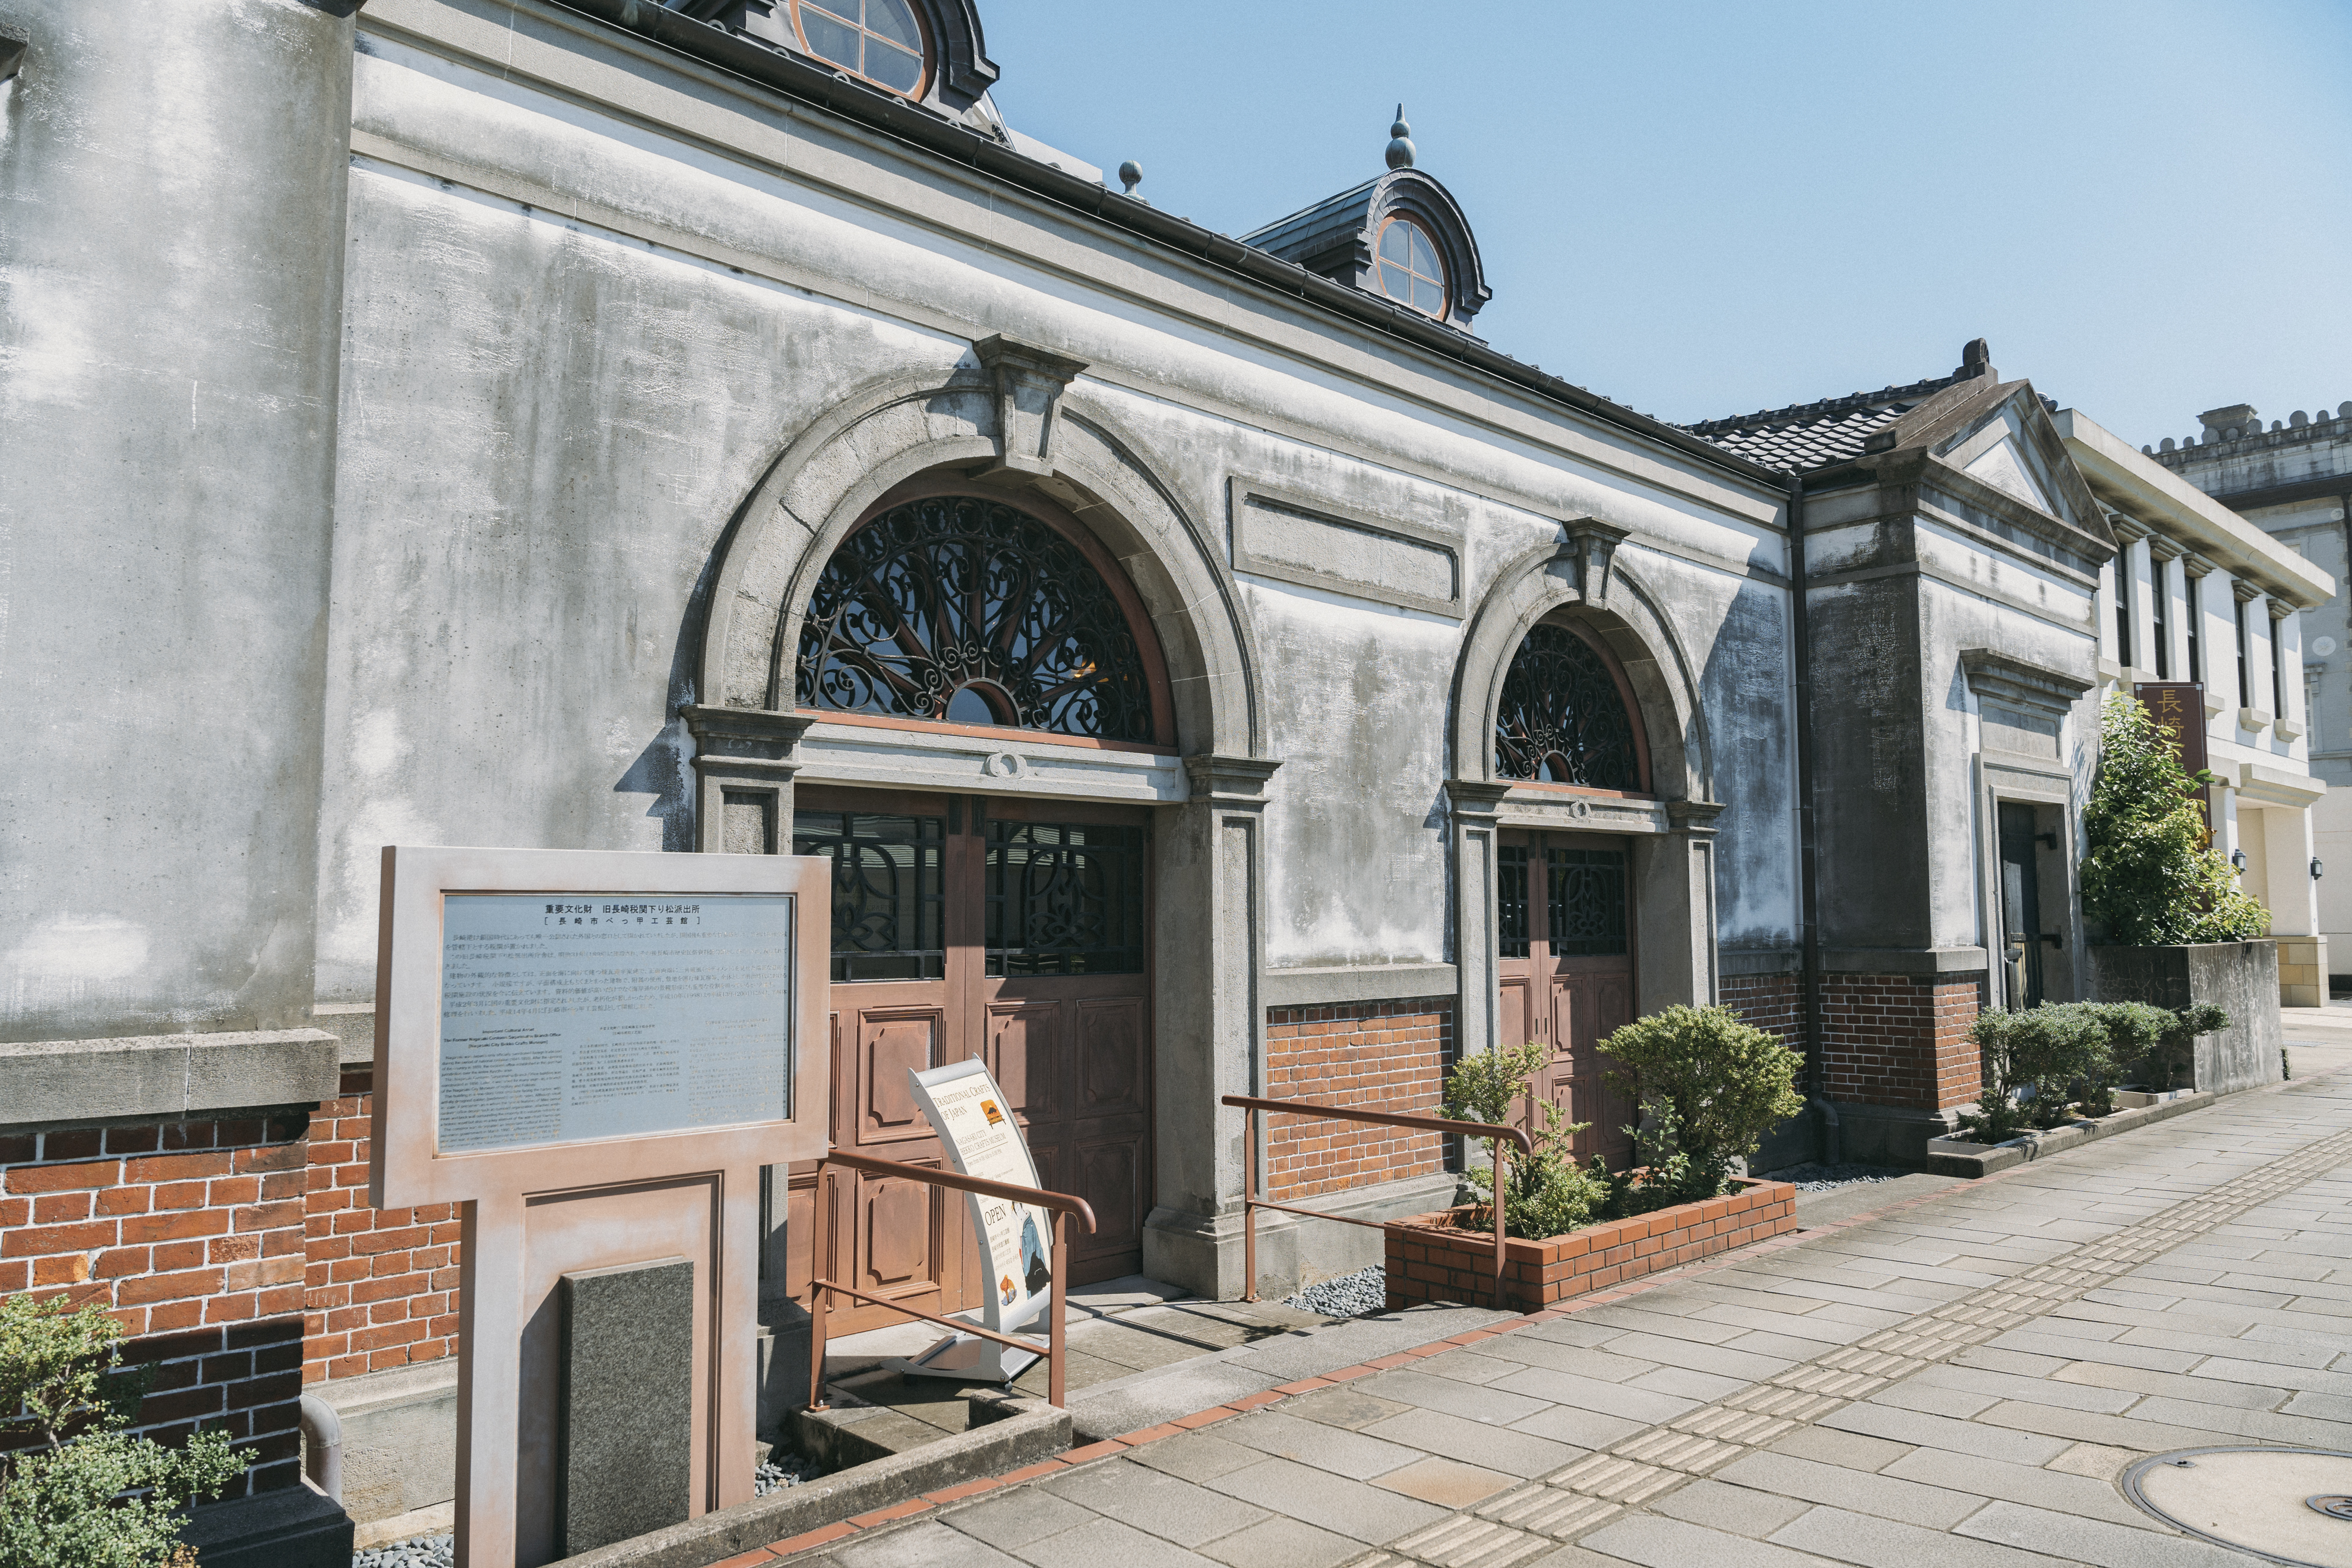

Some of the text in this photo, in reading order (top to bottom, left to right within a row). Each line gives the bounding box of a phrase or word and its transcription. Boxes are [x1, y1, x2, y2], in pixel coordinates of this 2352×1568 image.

[545, 905, 700, 914] 重要文化財 旧長崎税関下り松派出所
[932, 1084, 991, 1107] TRADITIONAL CRAFTS
[940, 1106, 967, 1120] OF JAPAN
[956, 1130, 987, 1146] NAGASAKI CITY
[960, 1133, 1006, 1156] BEKKO CRAFTS MUSEUM
[985, 1204, 1006, 1226] OPEN
